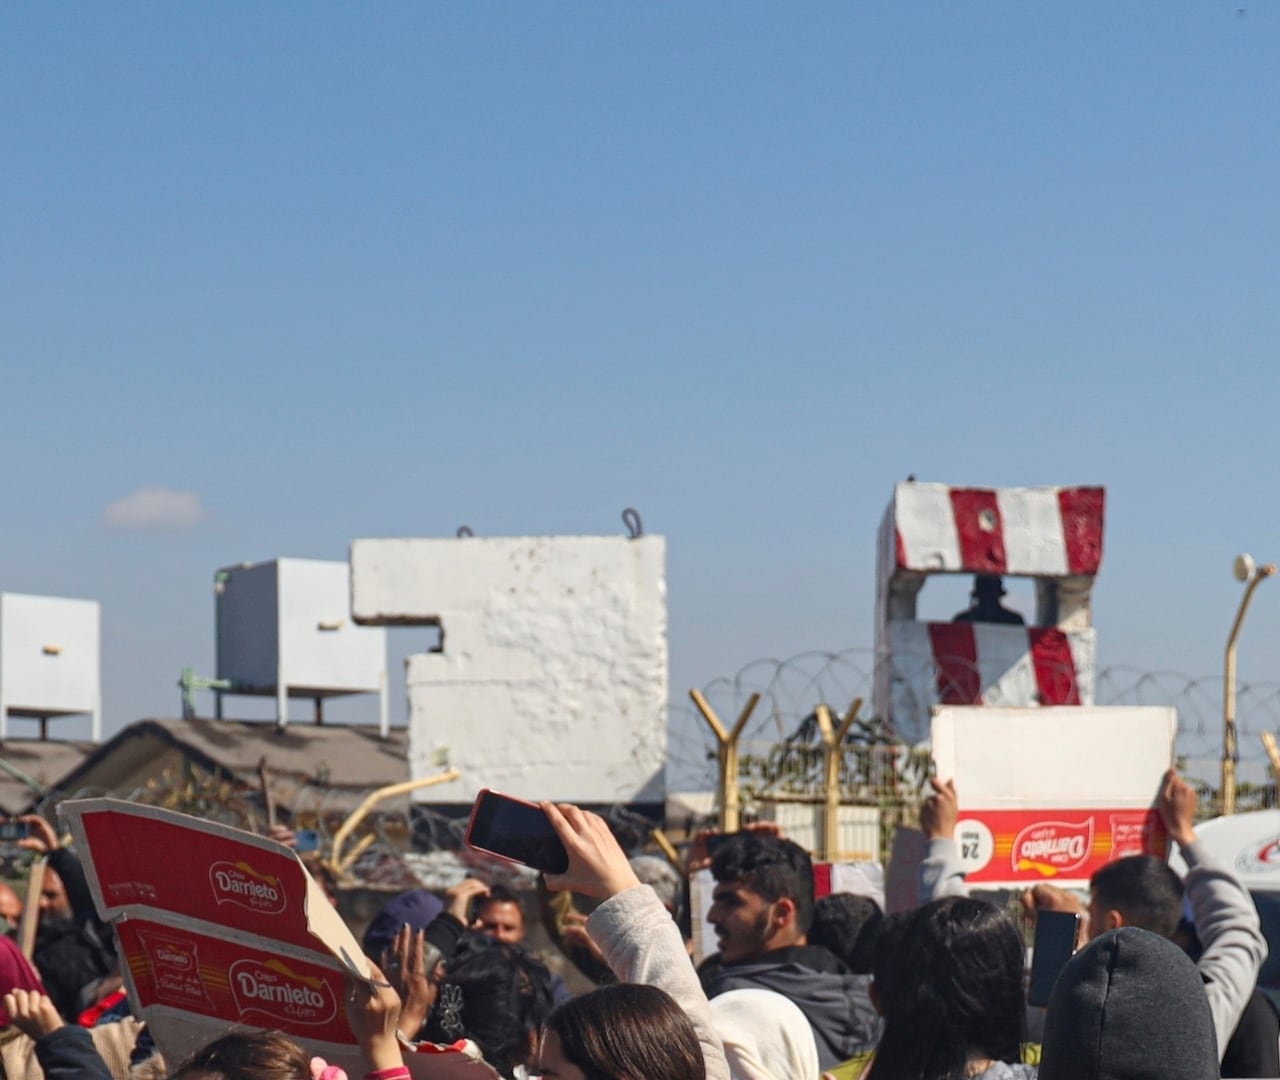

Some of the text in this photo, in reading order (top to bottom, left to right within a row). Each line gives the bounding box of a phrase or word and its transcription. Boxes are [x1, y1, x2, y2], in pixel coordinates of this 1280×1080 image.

[962, 843, 979, 859] 24
[215, 871, 277, 901] Darnieto
[237, 972, 324, 1008] Darnieto
